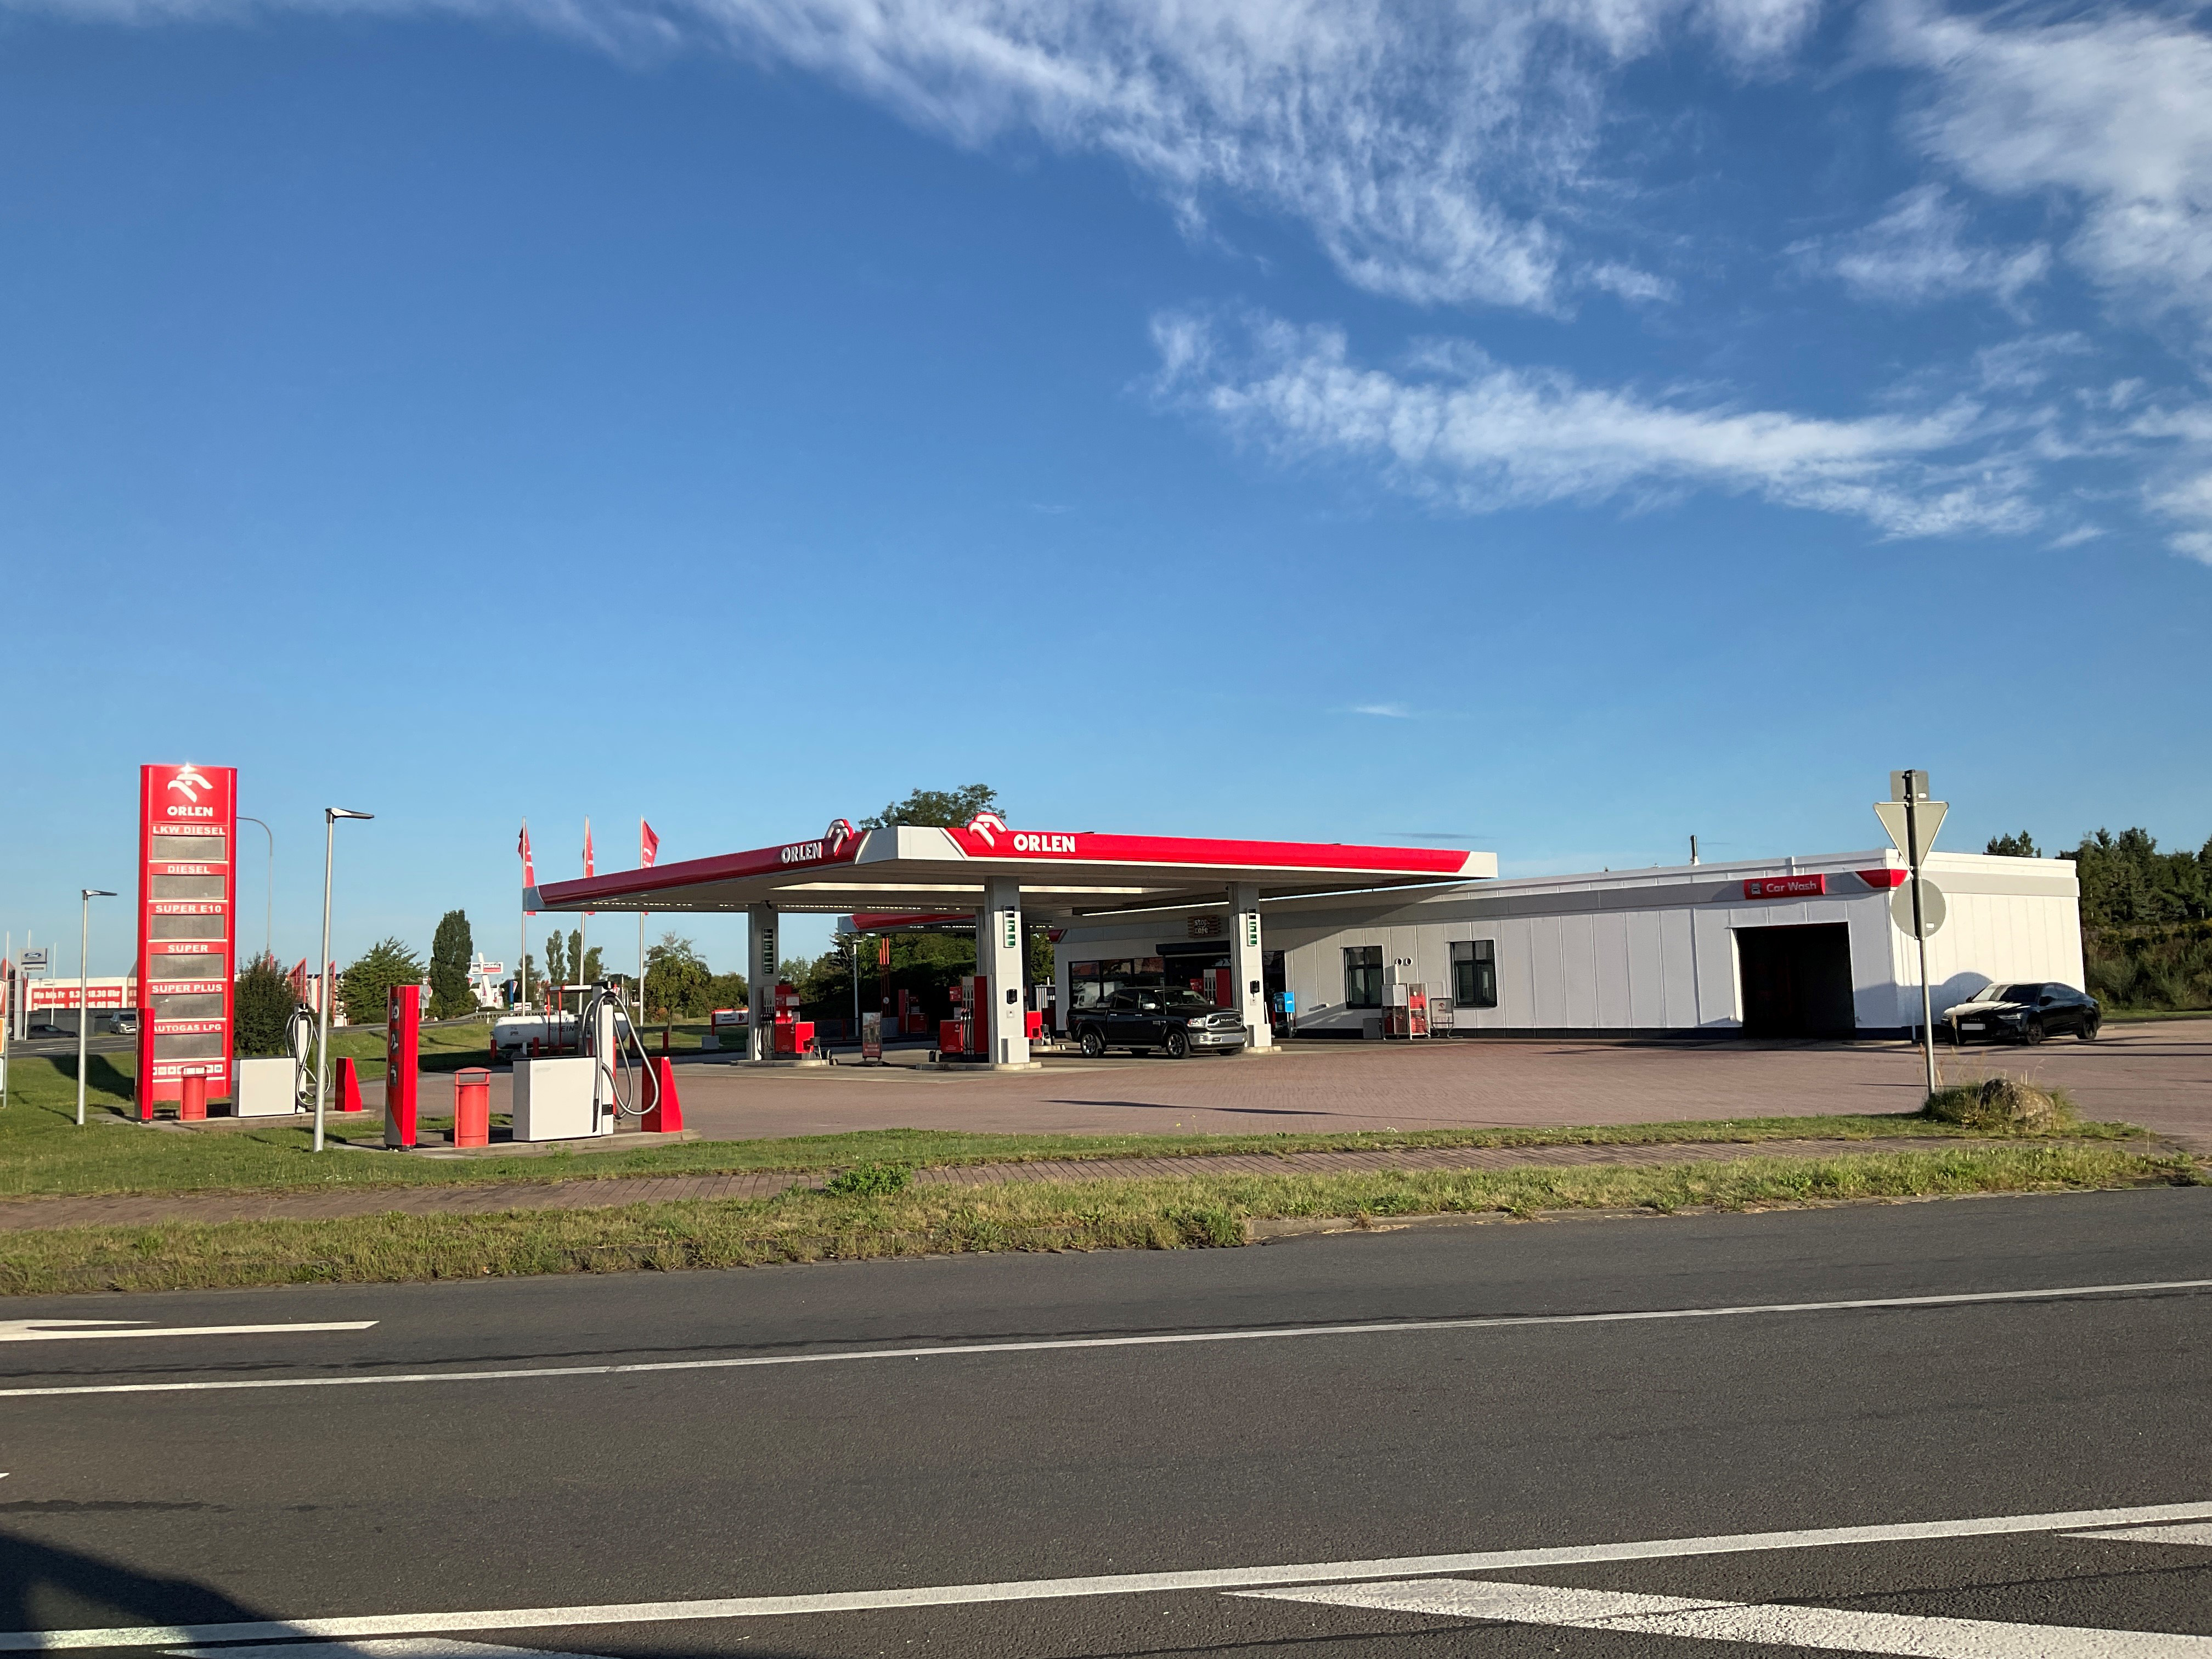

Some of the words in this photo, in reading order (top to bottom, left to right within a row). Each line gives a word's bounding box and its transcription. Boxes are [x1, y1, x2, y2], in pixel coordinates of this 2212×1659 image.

[167, 806, 213, 817] ORLEN
[153, 826, 179, 834] LKW
[184, 827, 225, 835] DIESEL
[1013, 833, 1076, 853] ORLEN
[781, 842, 822, 864] ORLEN
[167, 865, 211, 874] DIESEL
[1766, 883, 1785, 893] Car
[1787, 880, 1817, 892] Wash
[155, 905, 196, 913] SUPER
[200, 905, 222, 913] E10
[167, 944, 208, 952] SUPER
[152, 985, 191, 993] SUPER
[194, 984, 223, 992] PLUS
[69, 990, 106, 998] 9.3-18.30
[108, 989, 120, 997] Uhr
[154, 1024, 200, 1032] AUTOGAS
